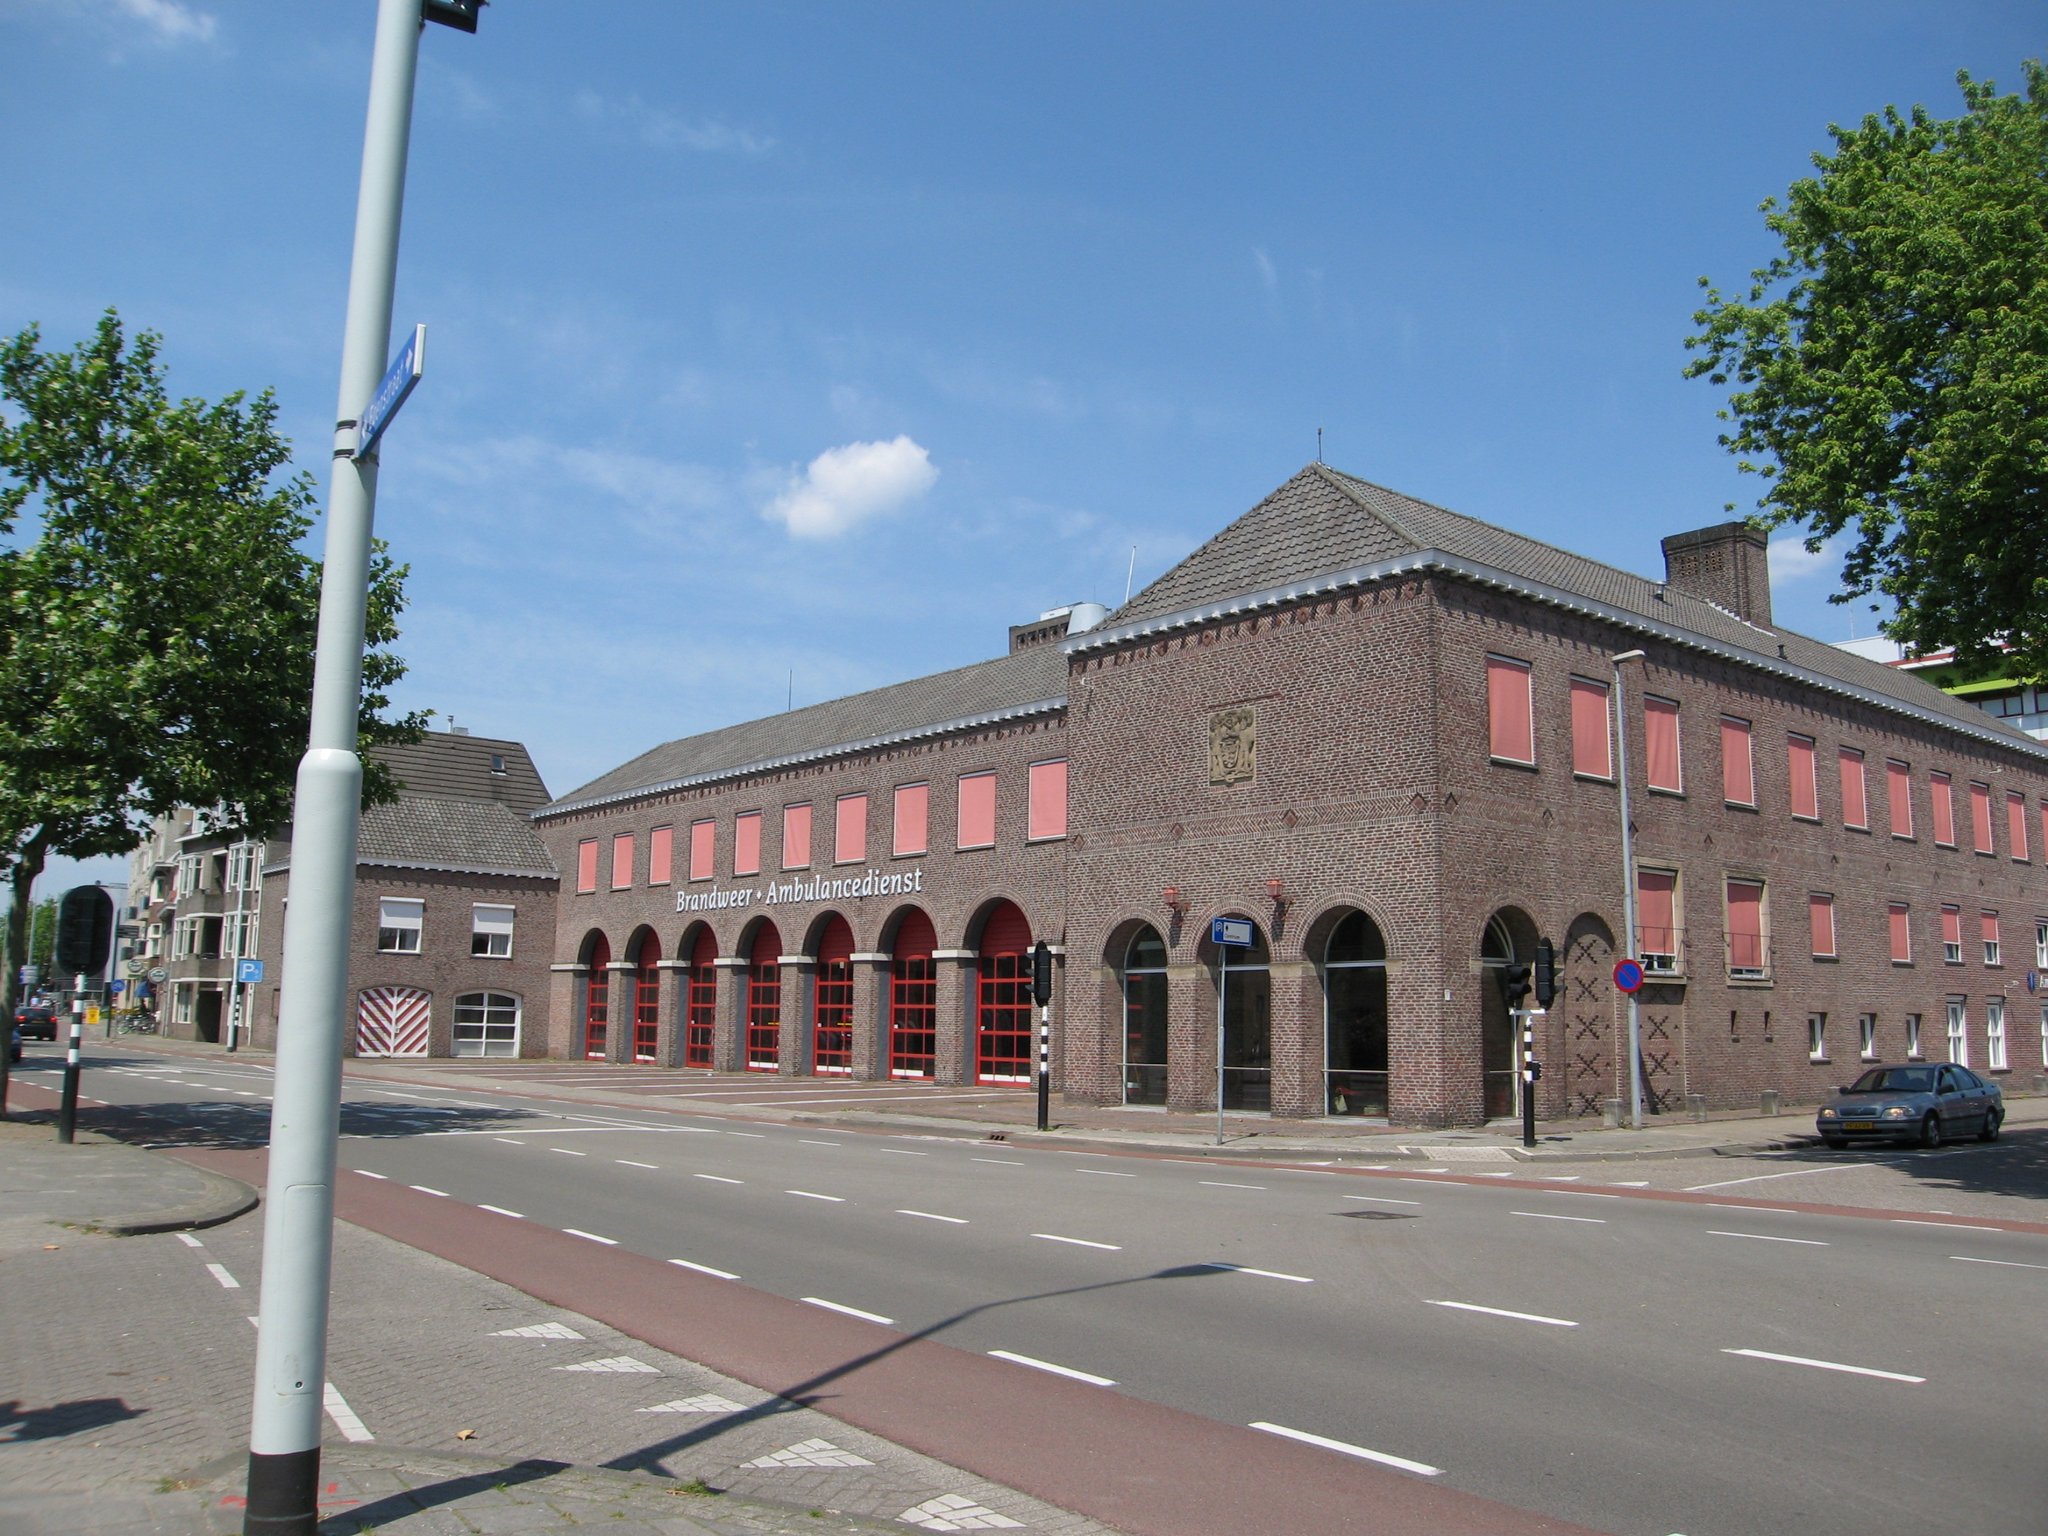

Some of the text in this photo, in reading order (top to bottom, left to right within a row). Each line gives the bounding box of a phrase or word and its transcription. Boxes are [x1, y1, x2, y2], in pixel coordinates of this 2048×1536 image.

[676, 867, 922, 912] Brandweer Ambulancedienst
[242, 963, 255, 979] P
